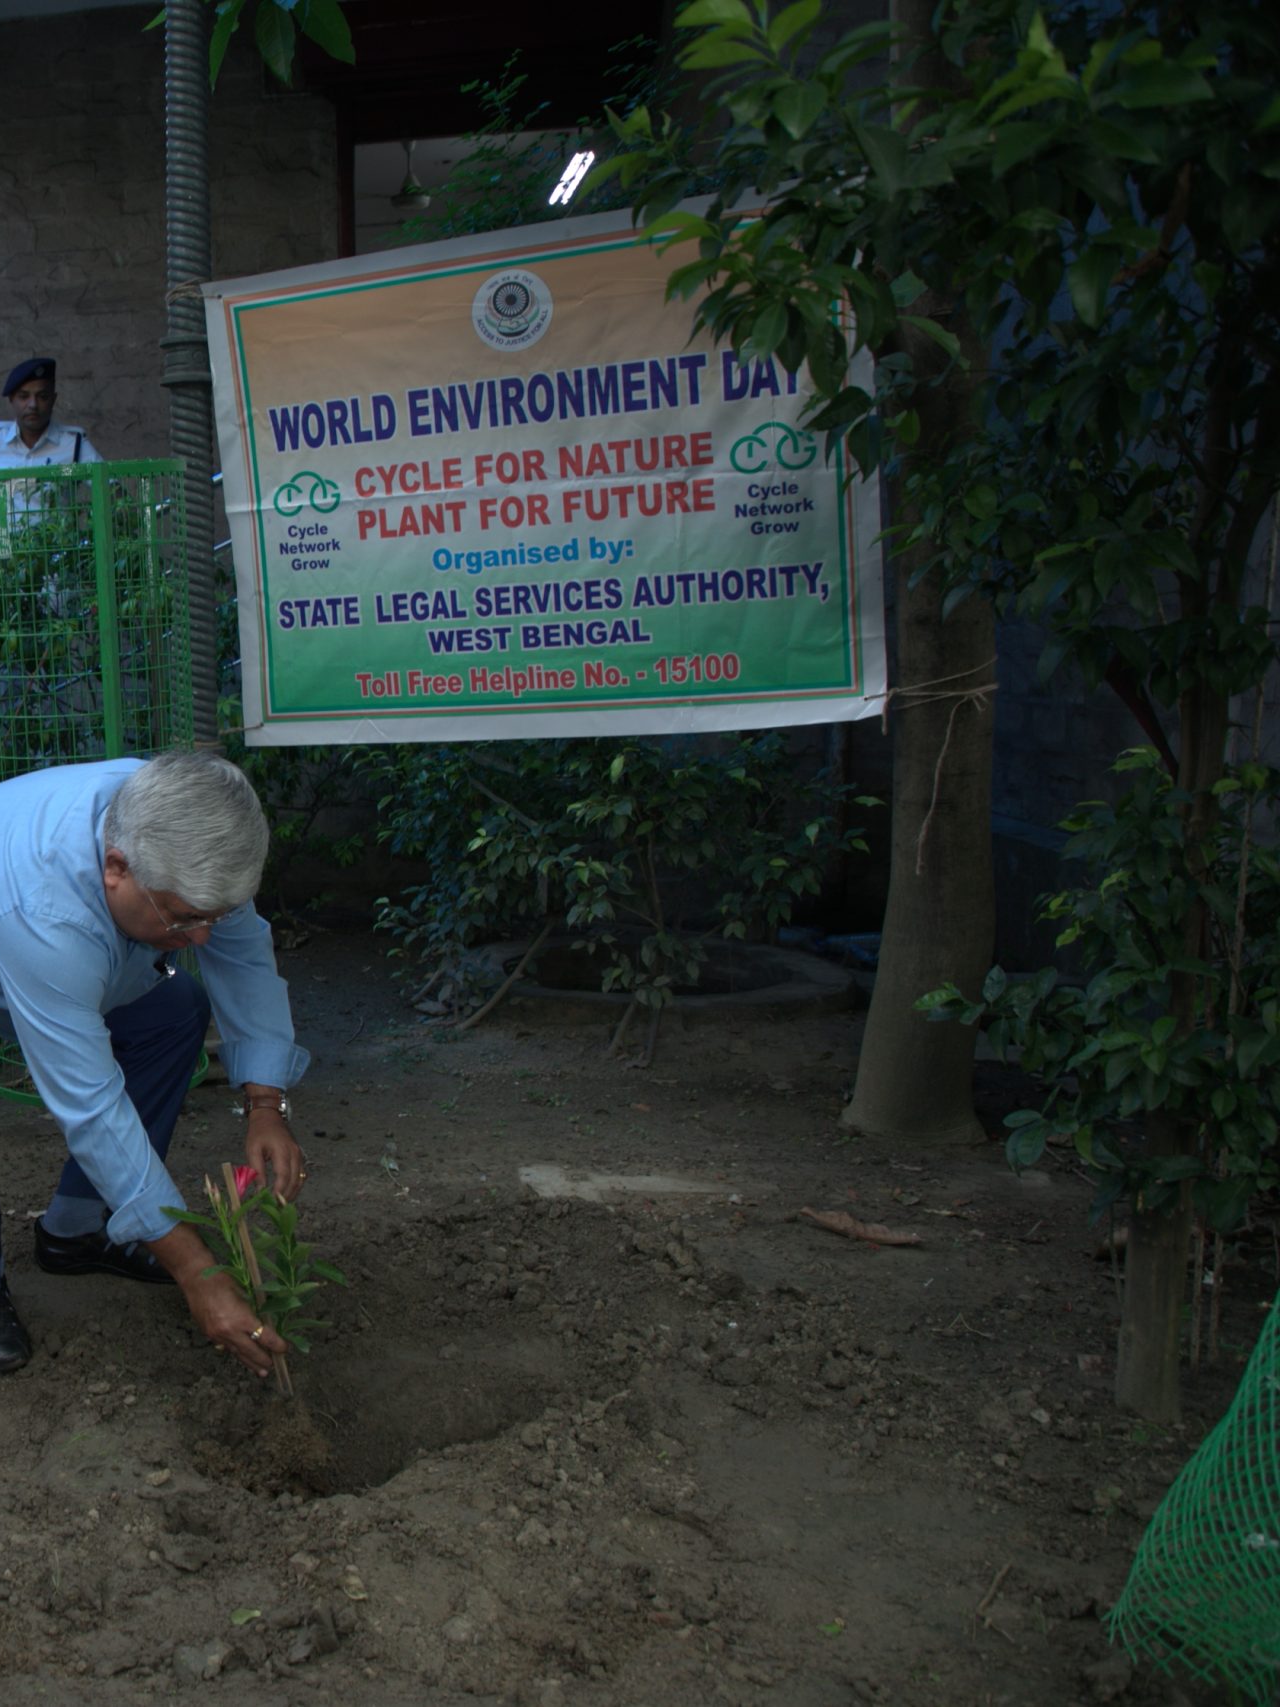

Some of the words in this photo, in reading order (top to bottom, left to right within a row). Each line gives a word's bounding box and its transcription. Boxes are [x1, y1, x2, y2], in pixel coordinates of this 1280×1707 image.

[477, 318, 494, 341] ACCESS
[495, 336, 504, 344] TO
[505, 335, 532, 346] JUSTICE
[532, 324, 542, 335] FOR
[540, 309, 549, 324] ALL
[269, 395, 396, 451] WORLD
[408, 352, 707, 436] ENVIRONMENT
[354, 458, 462, 496] CYCLE
[474, 450, 546, 486] FOR
[558, 431, 713, 478] NATURE
[734, 497, 814, 517] Network
[747, 481, 798, 500] Cycle
[357, 501, 466, 539] PLANT
[479, 494, 550, 529] FOR
[562, 478, 715, 522] FUTURE
[287, 522, 328, 540] Cycle
[750, 520, 799, 534] Grow
[279, 538, 340, 554] Network
[432, 538, 579, 574] Organised
[589, 536, 633, 564] by:
[290, 558, 329, 570] Grow
[279, 597, 359, 628] STATE
[376, 590, 466, 622] LEGAL
[475, 578, 622, 616] SERVICES
[633, 562, 831, 604] AUTHORITY,
[429, 630, 512, 654] WEST
[522, 620, 650, 650] BENGAL
[356, 672, 399, 696] Toll
[408, 671, 461, 694] Free
[470, 666, 575, 695] Helpline
[584, 662, 627, 686] No.
[655, 654, 738, 682] 15100
